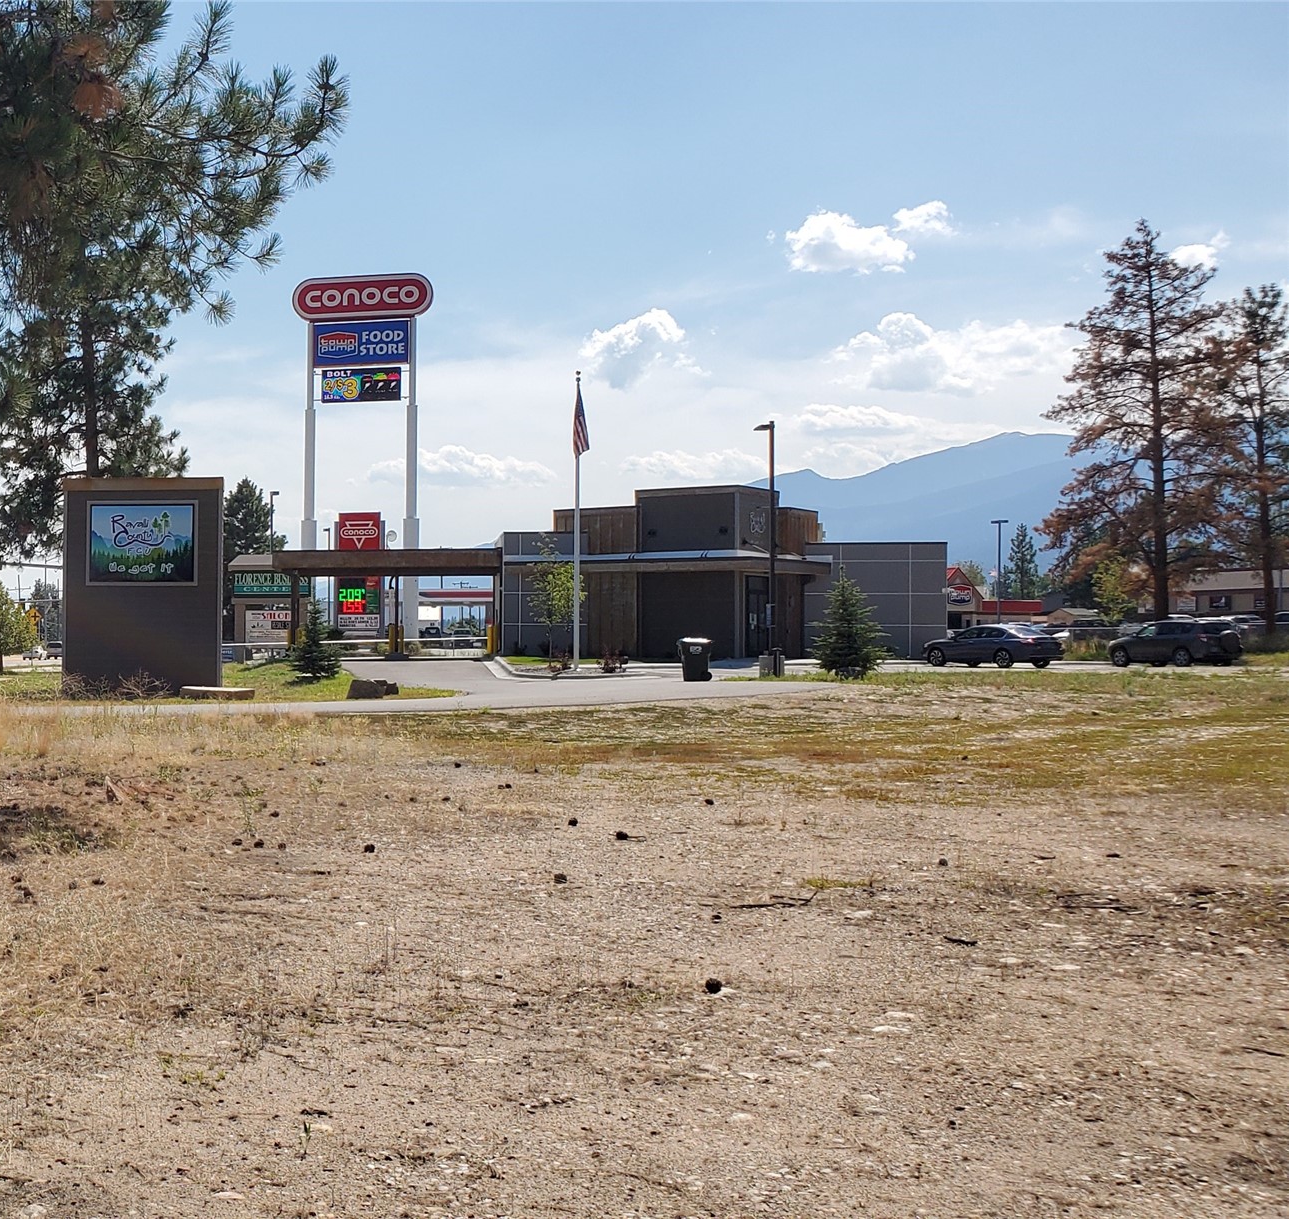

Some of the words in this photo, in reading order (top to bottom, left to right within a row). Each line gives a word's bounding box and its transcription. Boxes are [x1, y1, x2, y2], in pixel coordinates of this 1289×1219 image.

[305, 285, 420, 308] CONOCO
[362, 330, 404, 342] FOOD
[360, 343, 405, 355] STORE
[234, 573, 272, 585] FLORENCE
[262, 612, 290, 620] SALON
